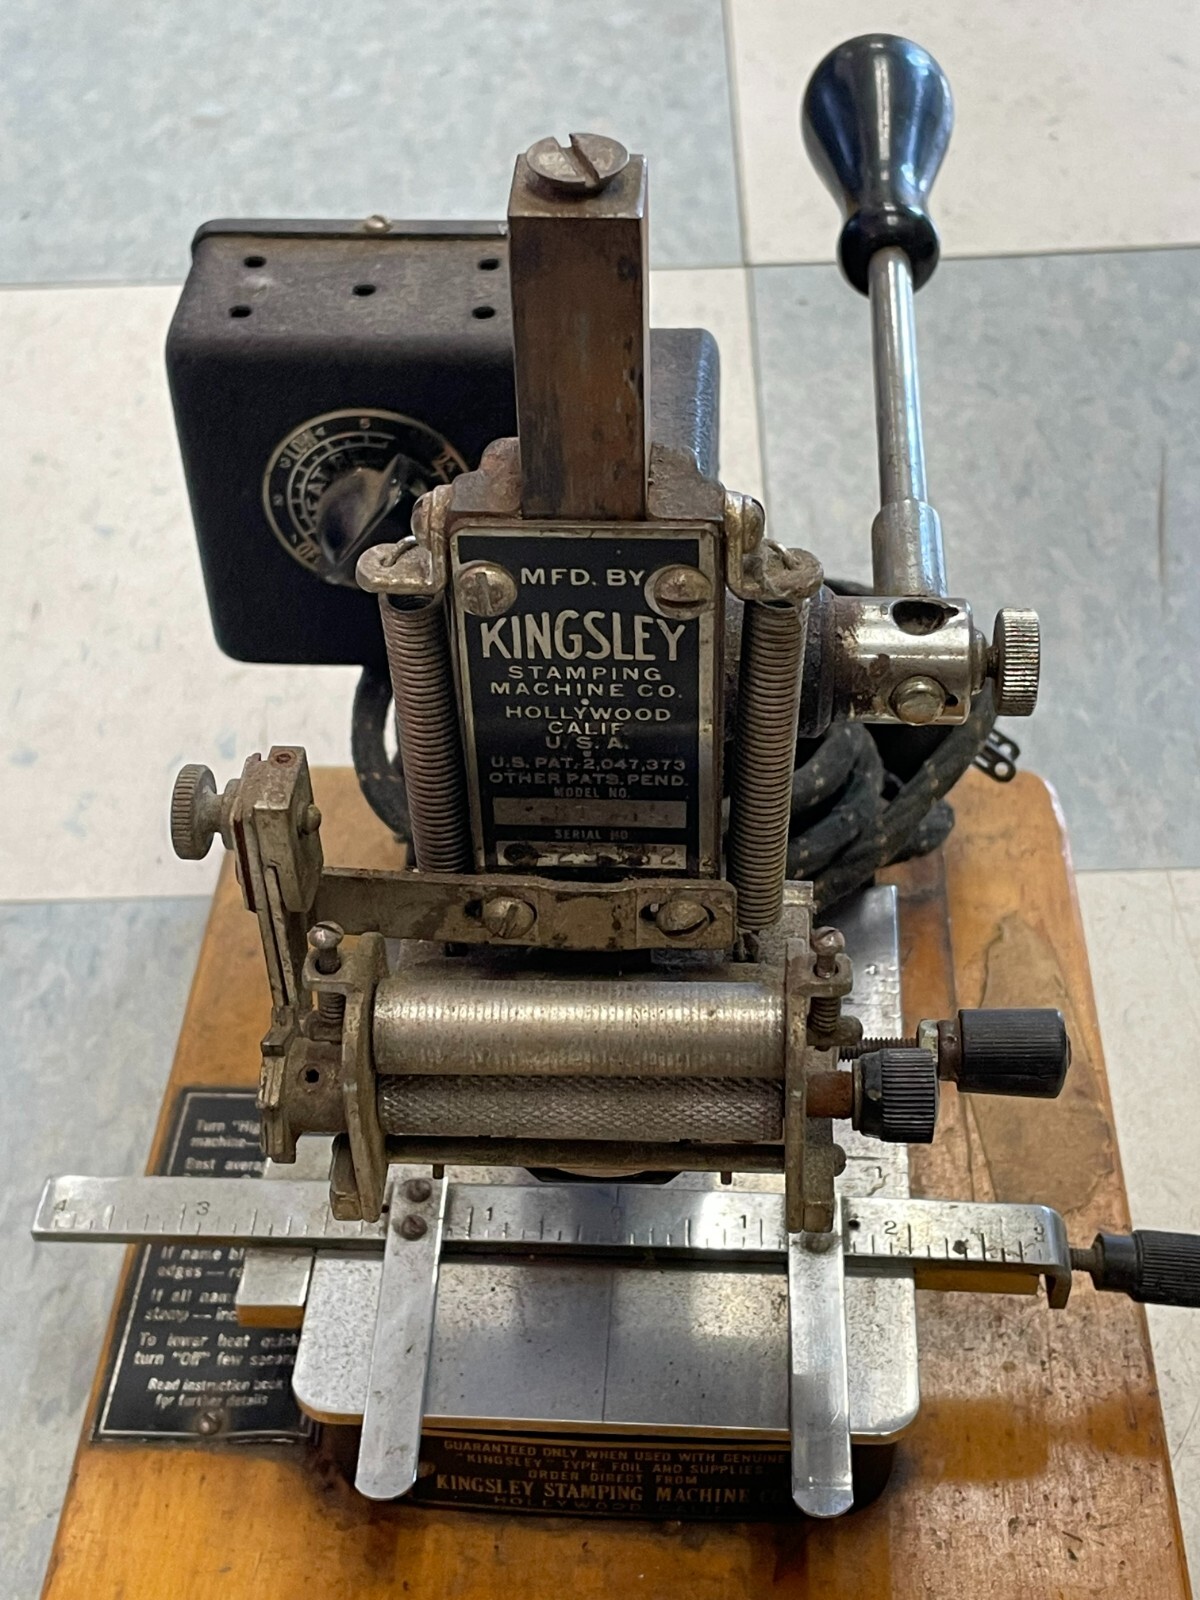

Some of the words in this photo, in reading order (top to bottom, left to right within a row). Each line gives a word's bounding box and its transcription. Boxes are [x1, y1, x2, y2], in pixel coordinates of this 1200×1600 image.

[521, 568, 597, 587] MFD.
[606, 568, 646, 587] BY
[479, 609, 687, 662] KINGSLEY
[507, 665, 663, 682] STAMPING
[489, 682, 625, 698] MACHINE
[637, 683, 683, 699] CO.
[505, 705, 672, 722] HOLLYWOOD
[582, 757, 687, 772] 2,047,373
[488, 772, 562, 785] OTHER
[553, 787, 600, 798] MODEL
[554, 829, 601, 841] SERIAL
[195, 1200, 211, 1217] 3
[883, 1219, 898, 1235] 2
[179, 1249, 222, 1261] name
[140, 1331, 157, 1347] To
[217, 1332, 251, 1348] heat
[133, 1350, 165, 1366] turn
[217, 1351, 244, 1366] few
[147, 1377, 181, 1391] Read
[181, 1378, 251, 1392] instruction
[443, 1440, 537, 1456] GUARANTEED
[542, 1447, 578, 1458] ONLY
[585, 1449, 629, 1460] WHEN
[633, 1451, 672, 1462] USED
[678, 1453, 716, 1463] WITH
[611, 1462, 643, 1473] FOIL
[589, 1472, 643, 1483] DIRECT
[655, 1474, 698, 1485] FROM
[436, 1473, 534, 1496] KINGSLEY
[543, 1482, 644, 1502] STAMPING
[655, 1486, 751, 1504] MACHINE
